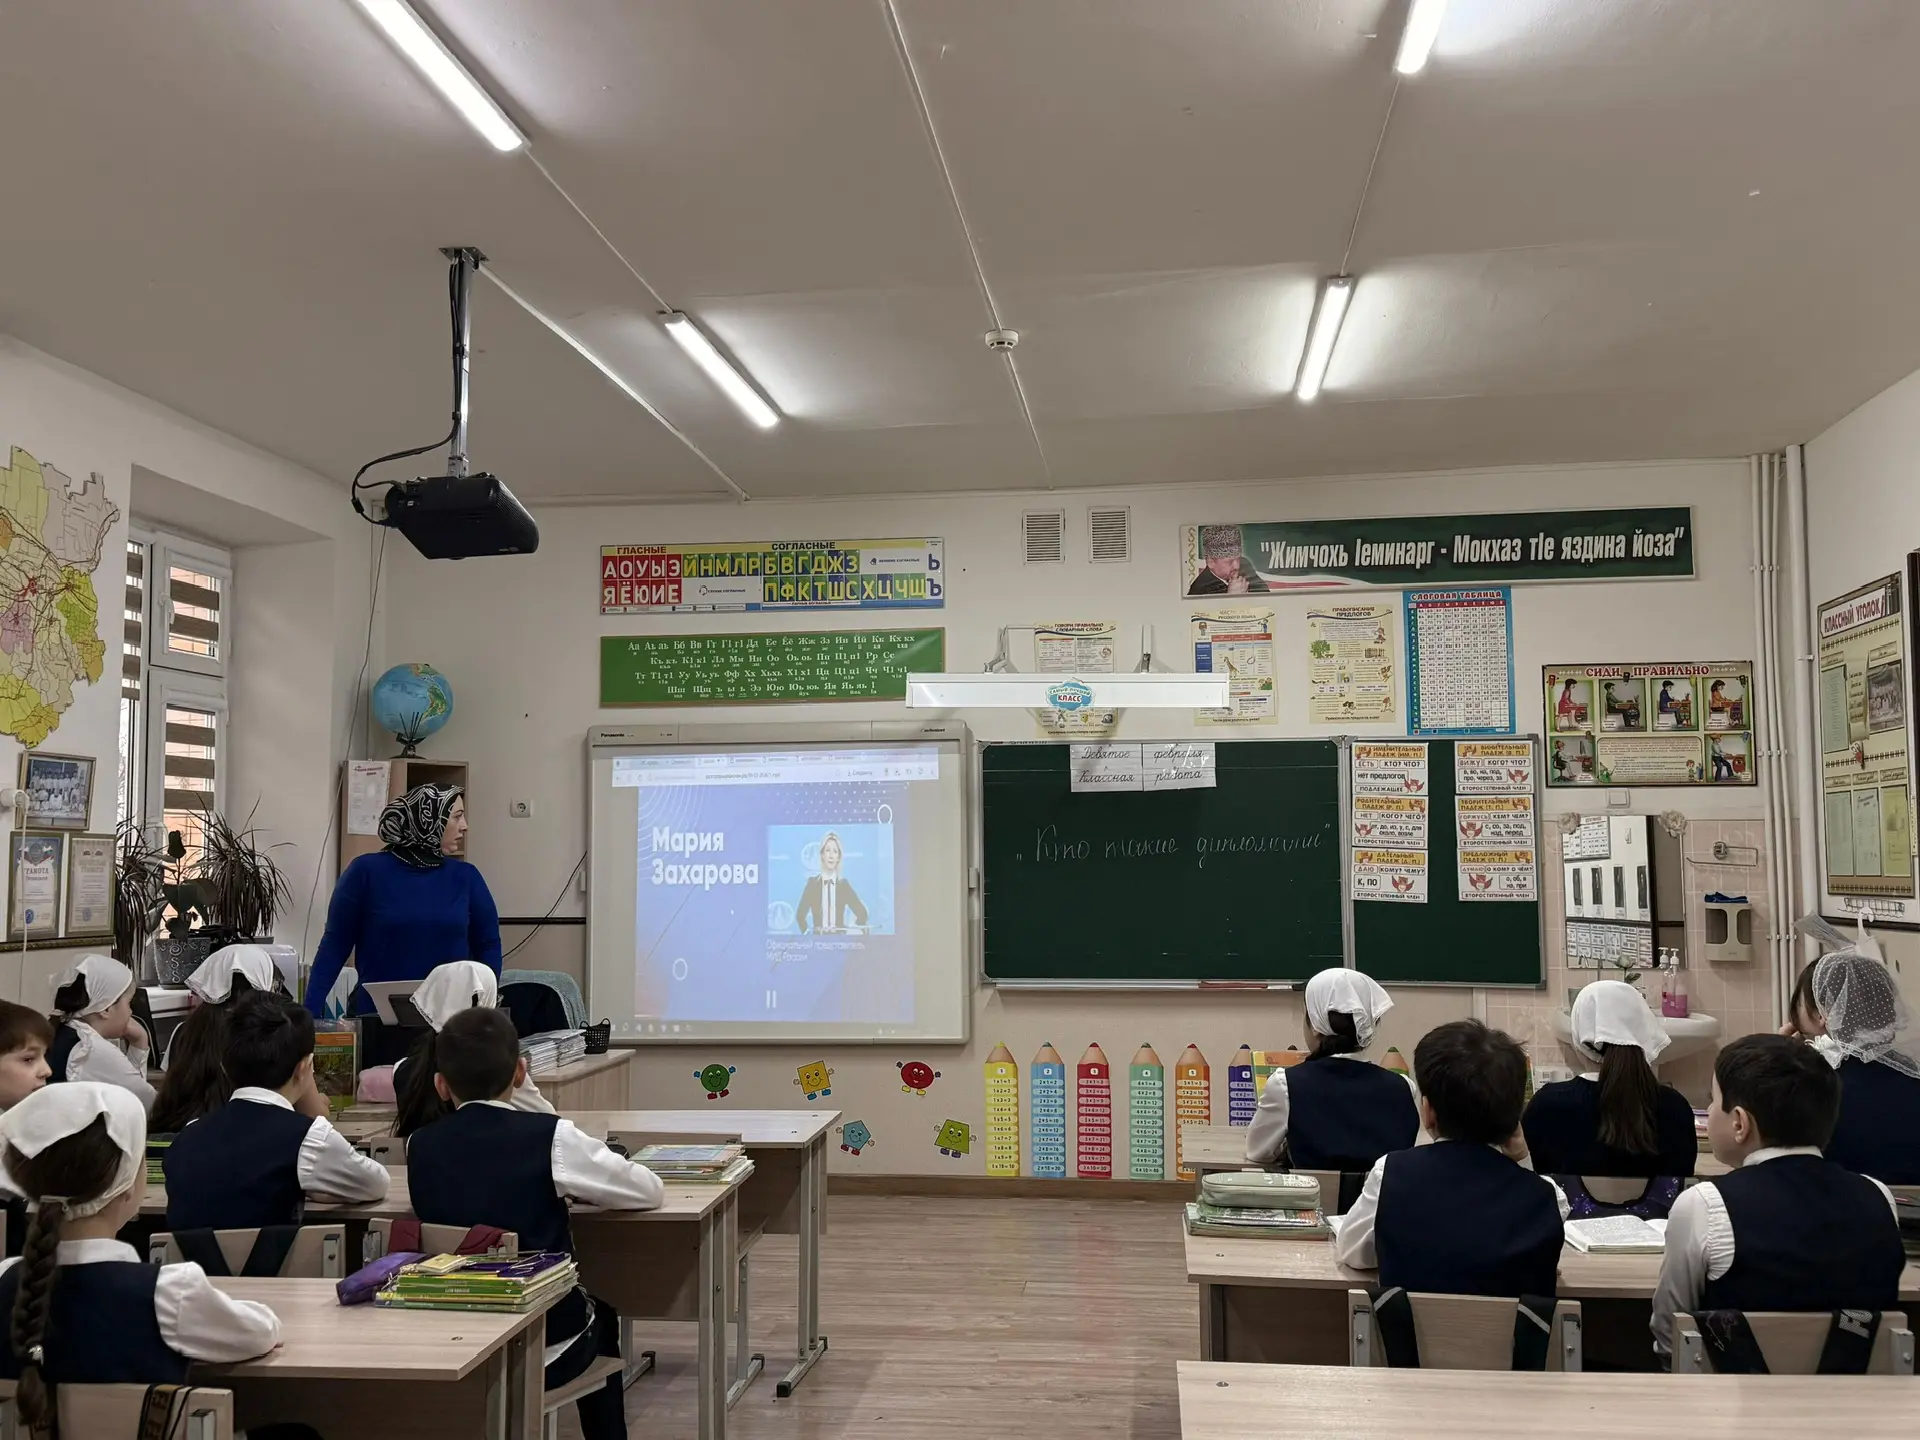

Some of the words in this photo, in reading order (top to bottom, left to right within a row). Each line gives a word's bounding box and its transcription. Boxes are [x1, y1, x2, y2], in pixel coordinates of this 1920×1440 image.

[617, 546, 666, 554] ГЛАСНЫЕ
[772, 542, 835, 550] СОГЛАСНЫЕ
[1261, 541, 1348, 569] "Жимчохь
[1453, 534, 1522, 563] Мокхаз
[1561, 534, 1626, 563] яздина
[1412, 592, 1457, 600] СЛОГОВАЯ
[1824, 604, 1854, 633] КЛАССНЫЙ
[1855, 598, 1880, 621] УГОЛОК
[1586, 667, 1621, 677] СИДИ
[1633, 665, 1710, 676] ПРАВИЛЬНО
[1081, 746, 1130, 759] Девятое
[1153, 745, 1204, 763] февраля
[1078, 769, 1135, 783] Классная
[1154, 770, 1202, 786] работа
[652, 826, 724, 858] Мария
[652, 860, 758, 890] Захарова
